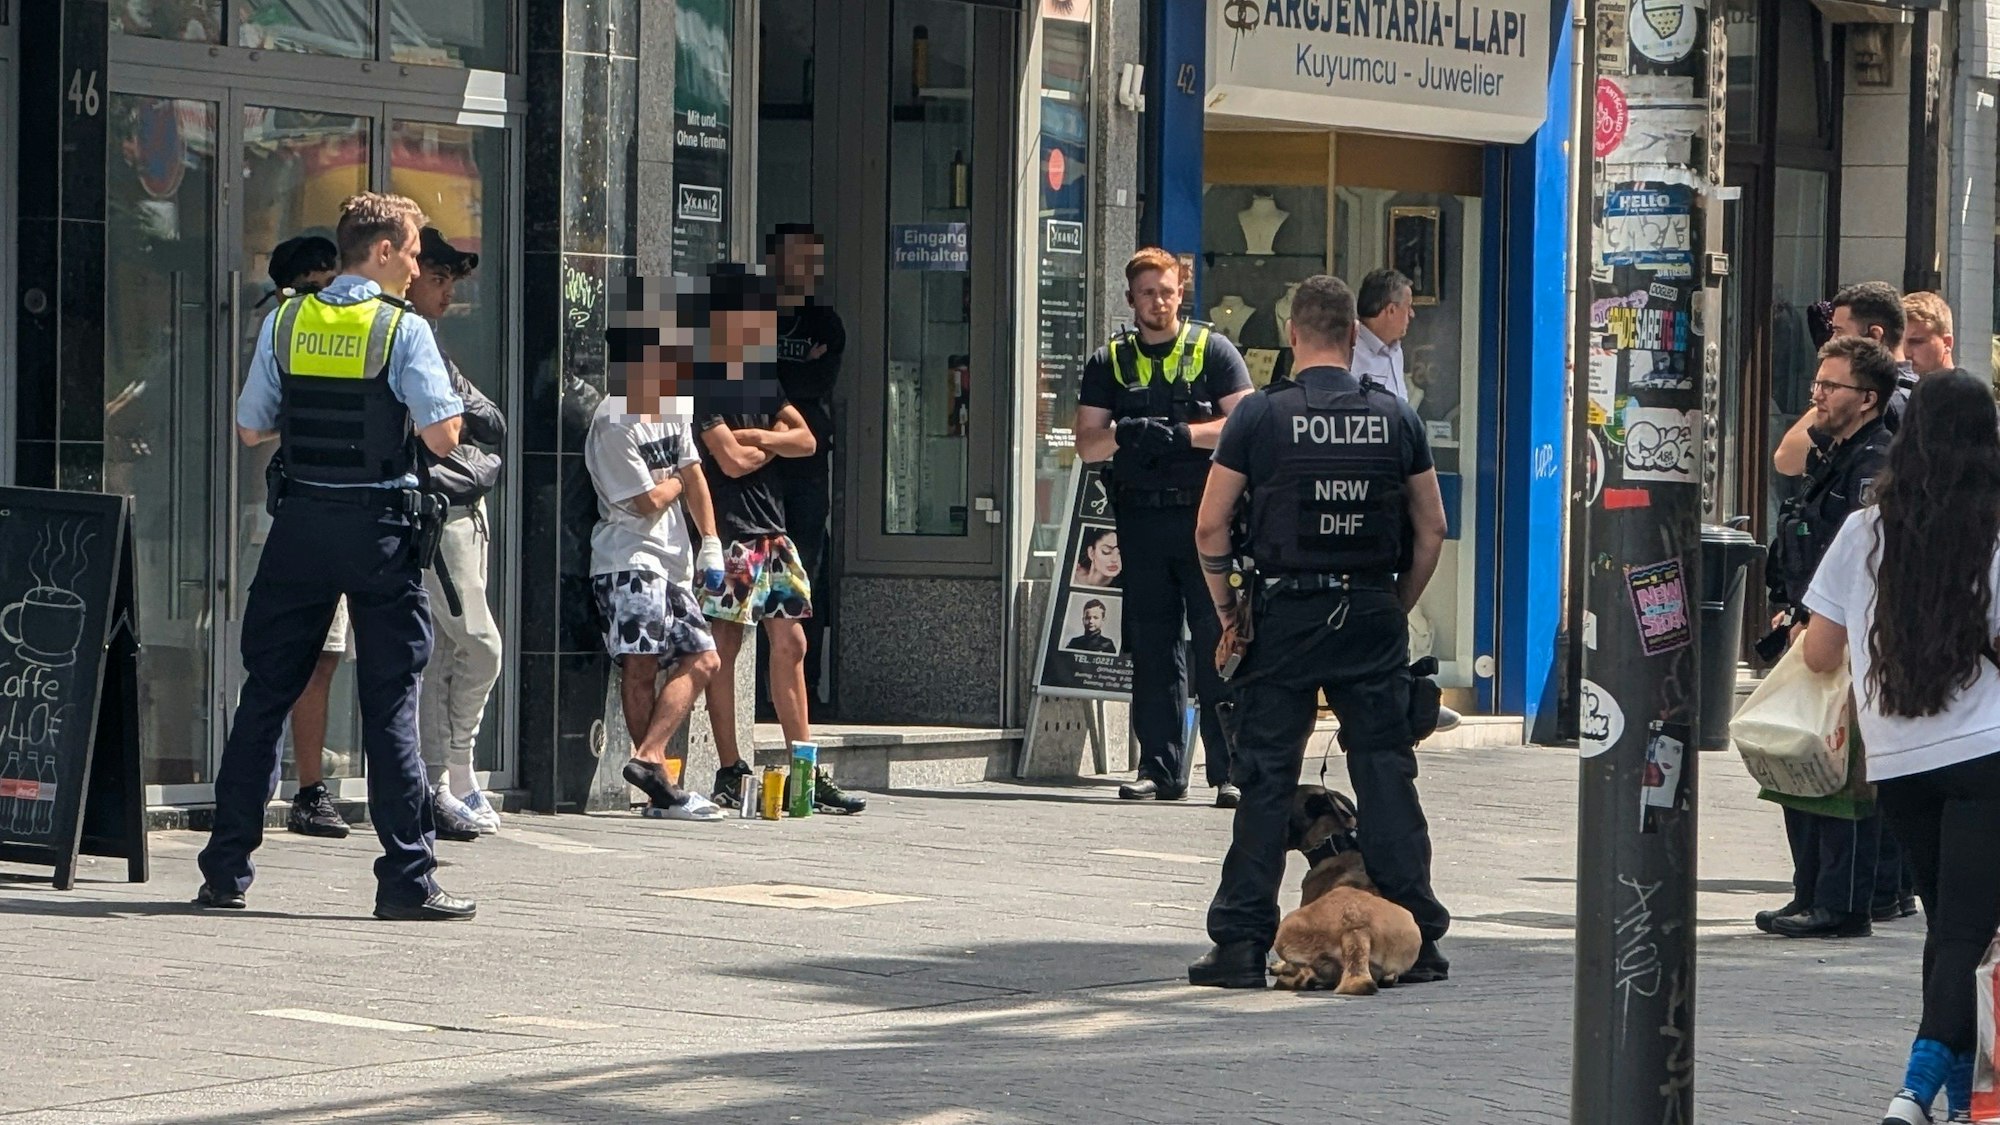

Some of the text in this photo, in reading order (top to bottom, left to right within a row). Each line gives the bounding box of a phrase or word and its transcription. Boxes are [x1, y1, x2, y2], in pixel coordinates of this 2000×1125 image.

[1177, 63, 1196, 95] 42
[1295, 43, 1397, 87] Kuyumcu
[1418, 57, 1504, 97] Juwelier
[68, 68, 100, 116] 46
[687, 109, 717, 128] Mit und
[677, 130, 726, 150] Ohne Termin
[1620, 194, 1670, 208] HELLO
[904, 230, 967, 247] Eingang
[895, 247, 969, 262] freihalten
[295, 331, 362, 358] POLIZEI
[1292, 415, 1389, 444] POLIZEI
[1315, 480, 1370, 501] NRW
[1320, 513, 1364, 535] DHF
[1614, 874, 1662, 1050] AMOR
